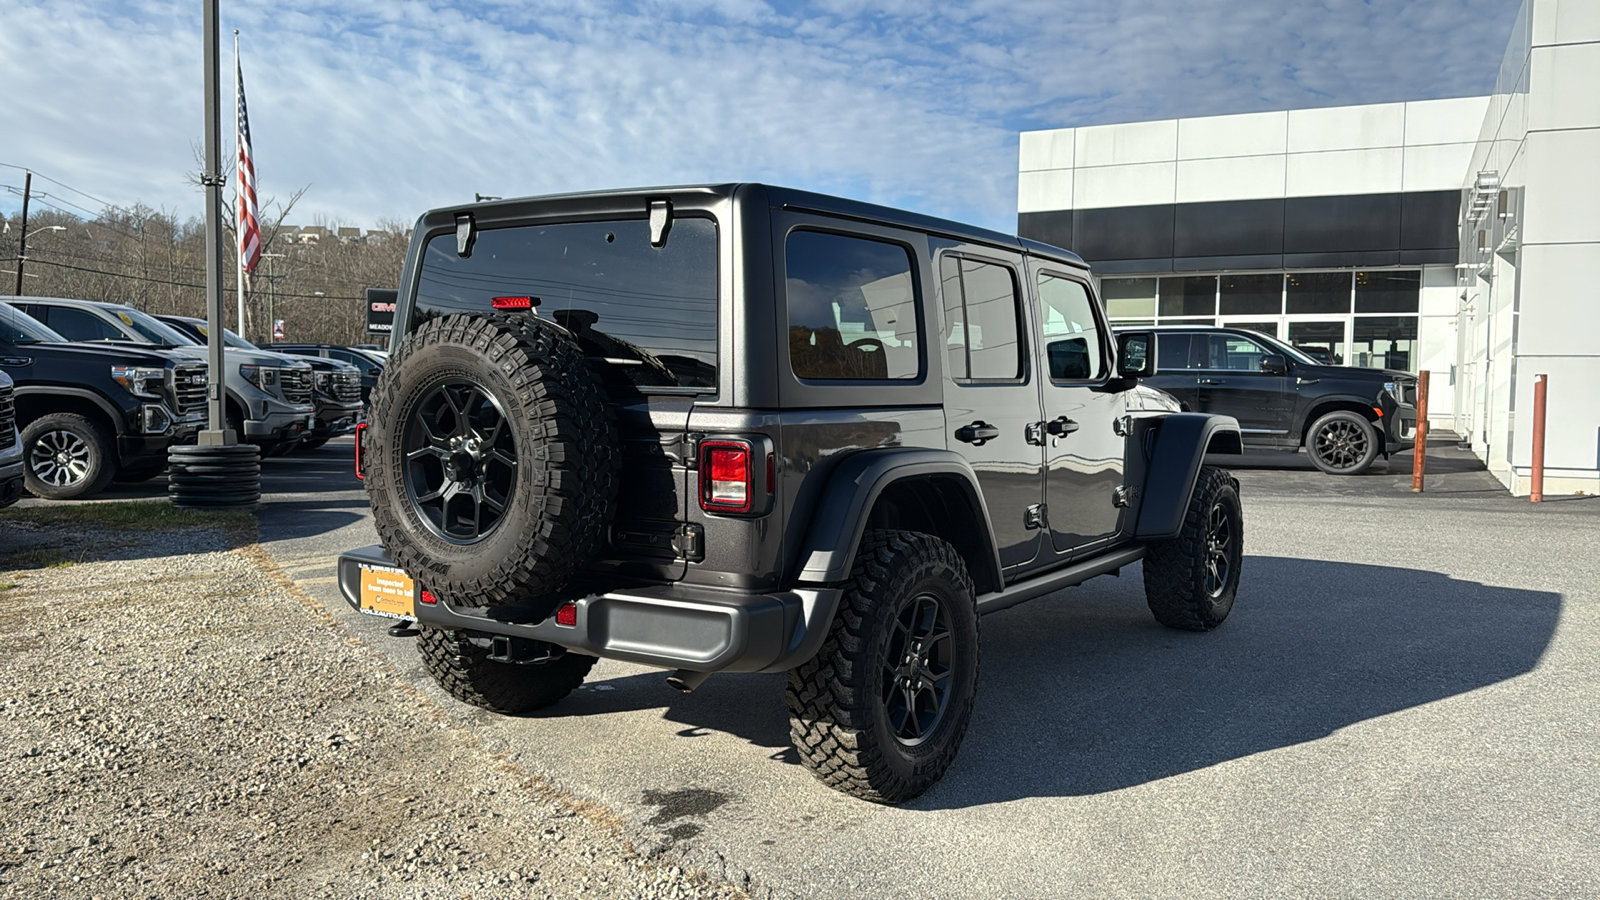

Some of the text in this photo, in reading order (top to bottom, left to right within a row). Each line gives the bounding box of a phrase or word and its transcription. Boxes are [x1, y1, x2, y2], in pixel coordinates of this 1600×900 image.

[371, 302, 396, 312] GM
[367, 583, 382, 592] from
[376, 577, 404, 588] Inspected
